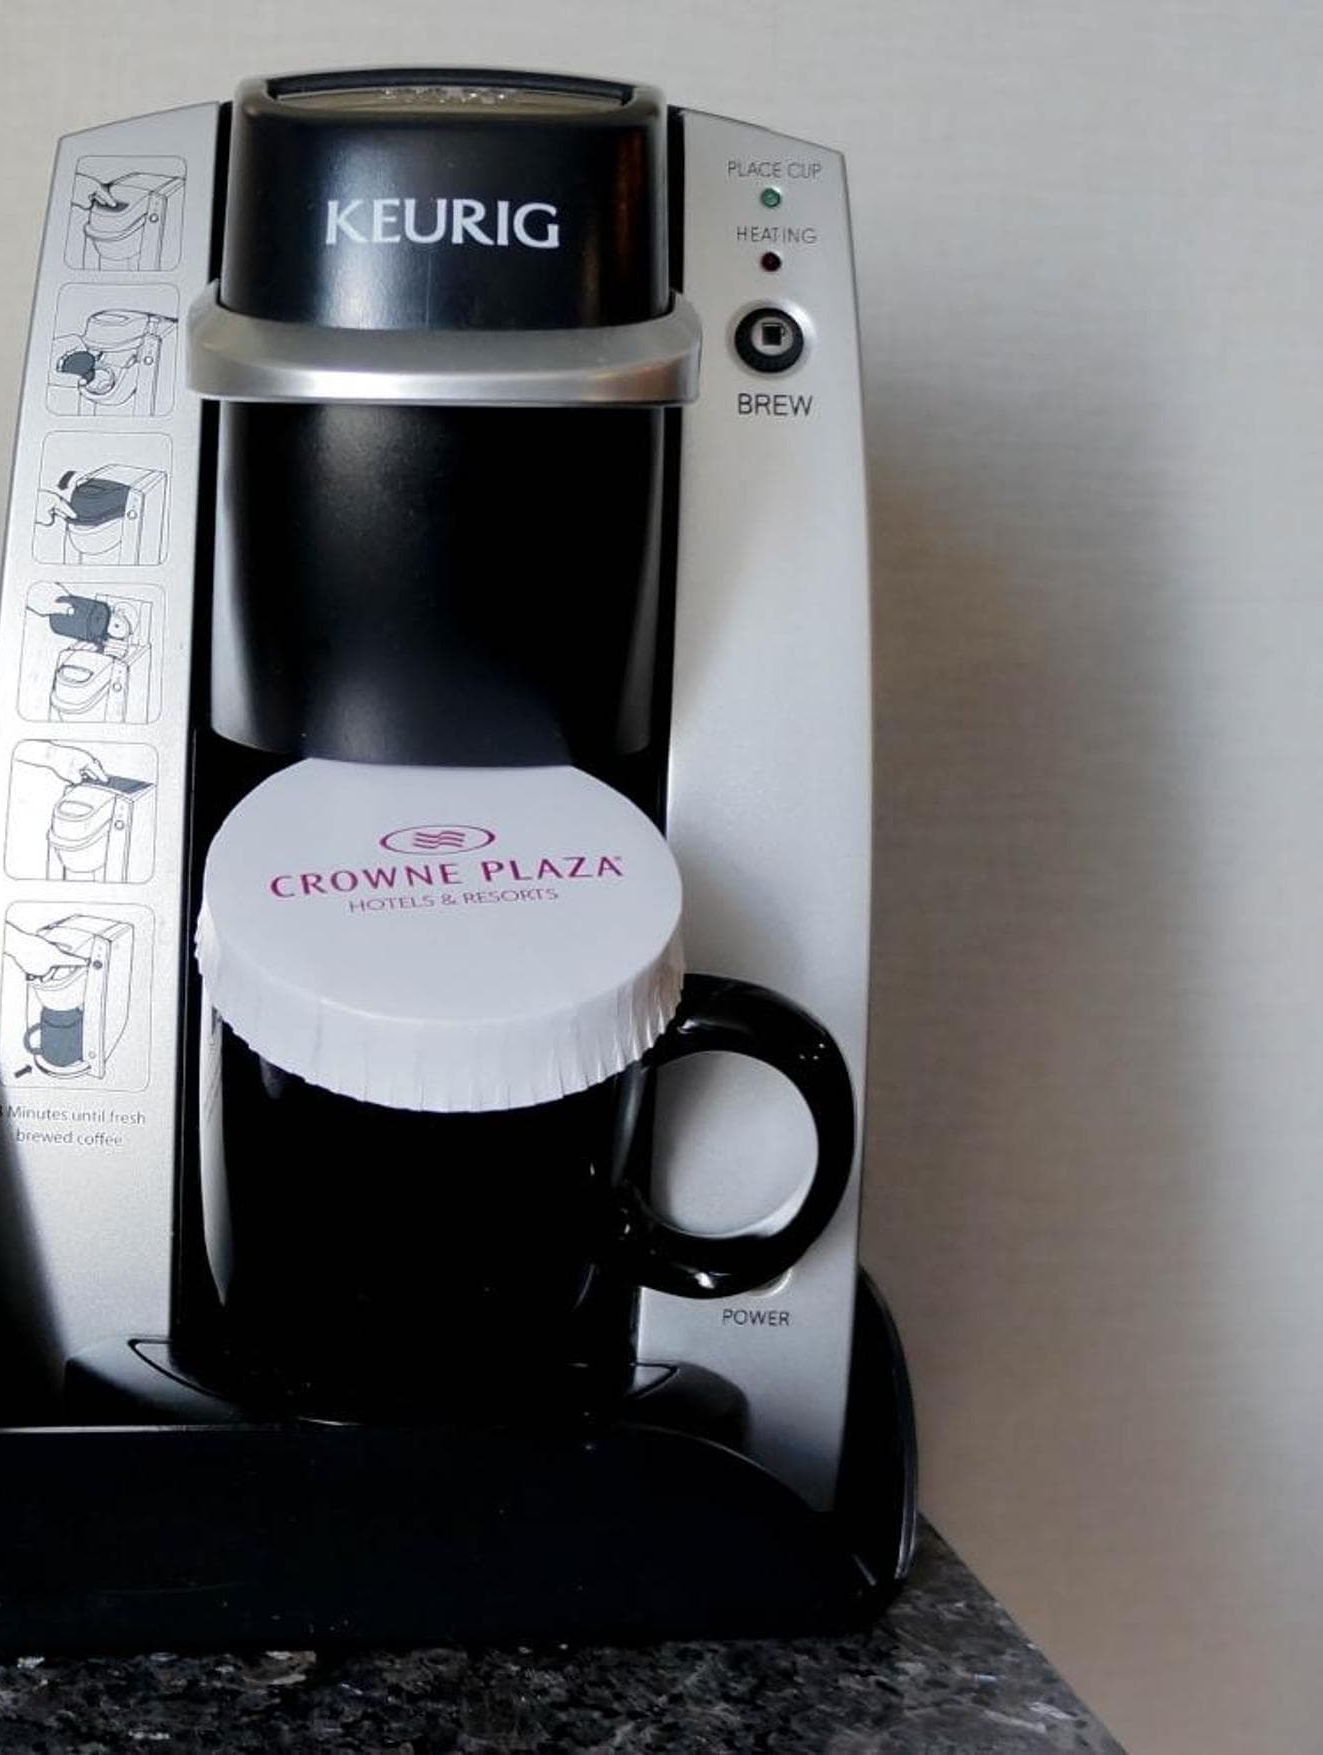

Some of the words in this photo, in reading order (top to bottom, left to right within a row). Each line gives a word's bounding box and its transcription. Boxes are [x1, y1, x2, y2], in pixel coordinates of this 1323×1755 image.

[728, 161, 781, 178] PLACE
[788, 163, 822, 179] CUP
[326, 198, 560, 249] KEURIG
[737, 226, 817, 243] HEATING
[738, 393, 813, 416] BREW
[270, 862, 463, 898] CROWNE
[349, 895, 435, 914] HOTELS
[440, 893, 457, 906] &
[463, 888, 558, 905] RESORTS
[8, 1105, 72, 1121] Minutes
[72, 1109, 105, 1122] until
[110, 1108, 146, 1125] fresh
[16, 1128, 73, 1144] brewed
[77, 1131, 123, 1147] coffee
[722, 1309, 790, 1327] POWER
